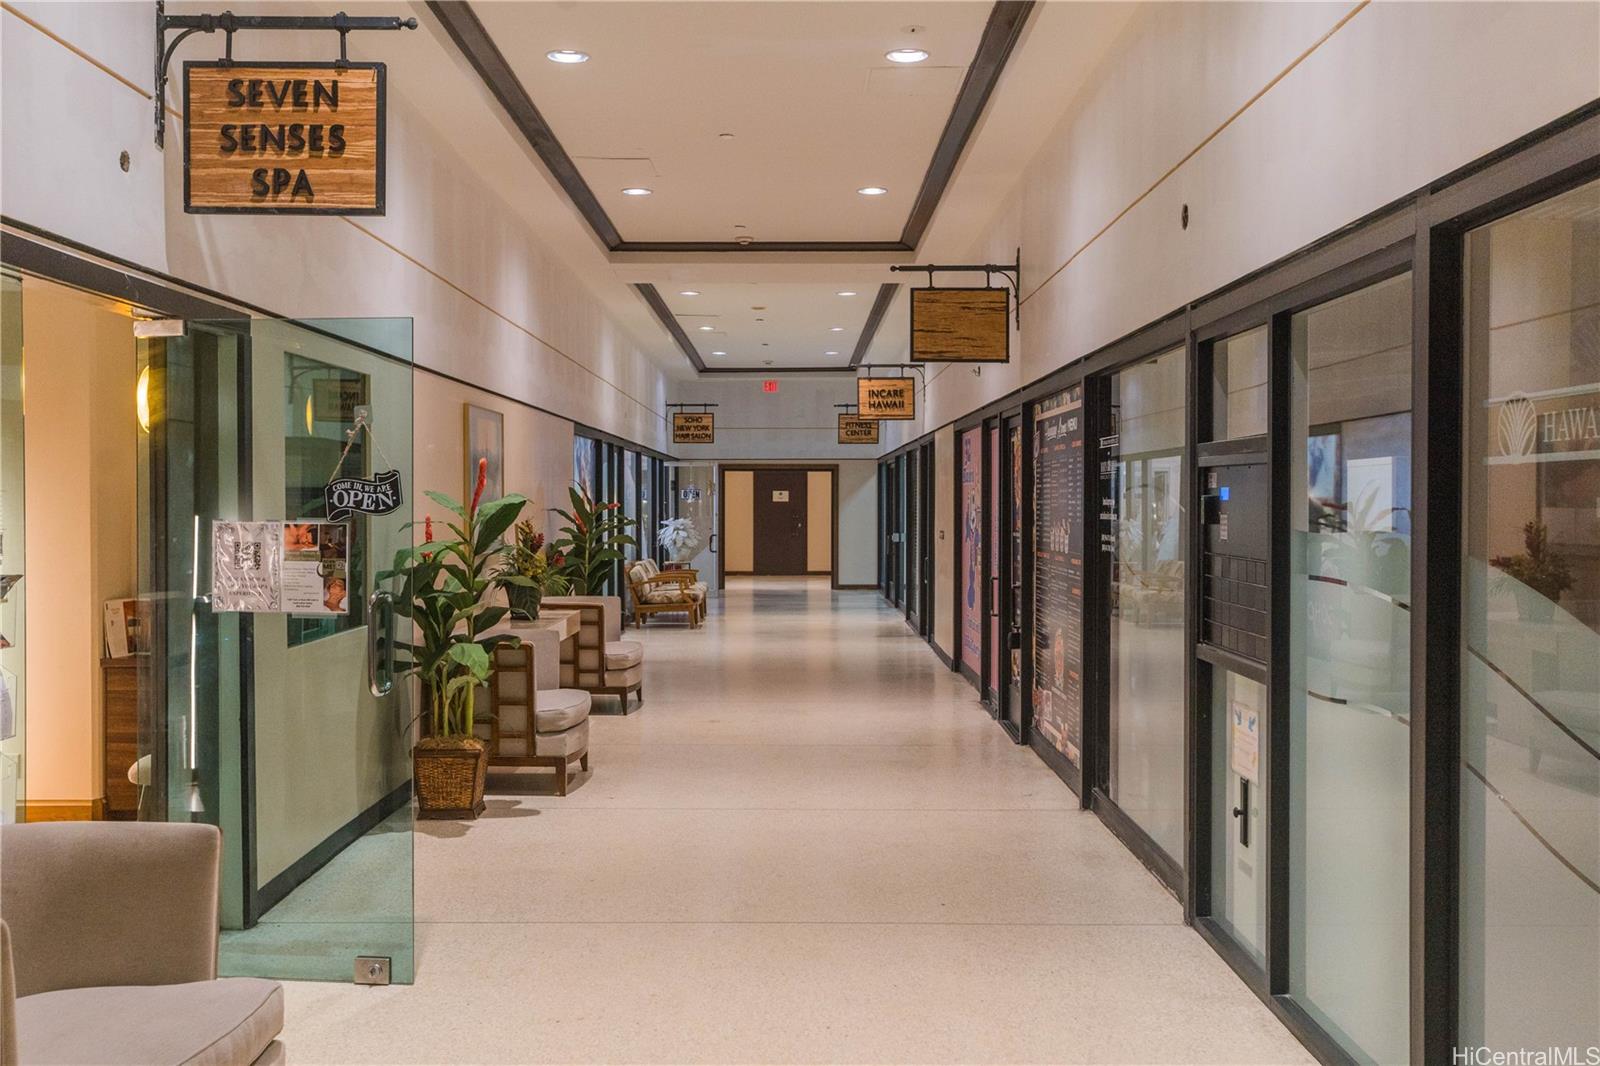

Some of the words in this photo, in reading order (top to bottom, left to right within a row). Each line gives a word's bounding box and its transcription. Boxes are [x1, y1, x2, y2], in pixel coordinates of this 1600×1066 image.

[227, 79, 339, 111] SEVEN
[220, 123, 346, 156] SENSES
[252, 168, 315, 201] SPA
[868, 389, 904, 399] INCARE
[868, 400, 904, 409] HAWAII
[676, 424, 692, 432] NEW
[693, 424, 710, 432] YORK
[845, 421, 872, 429] FITNESS
[1543, 407, 1600, 442] HAWA
[675, 432, 690, 440] HAIR
[691, 432, 711, 440] SALON
[845, 429, 872, 437] CENTER
[332, 481, 352, 492] COME
[353, 482, 363, 491] IN,
[364, 484, 375, 493] WE
[376, 483, 392, 493] ARE
[333, 489, 394, 510] OPEN
